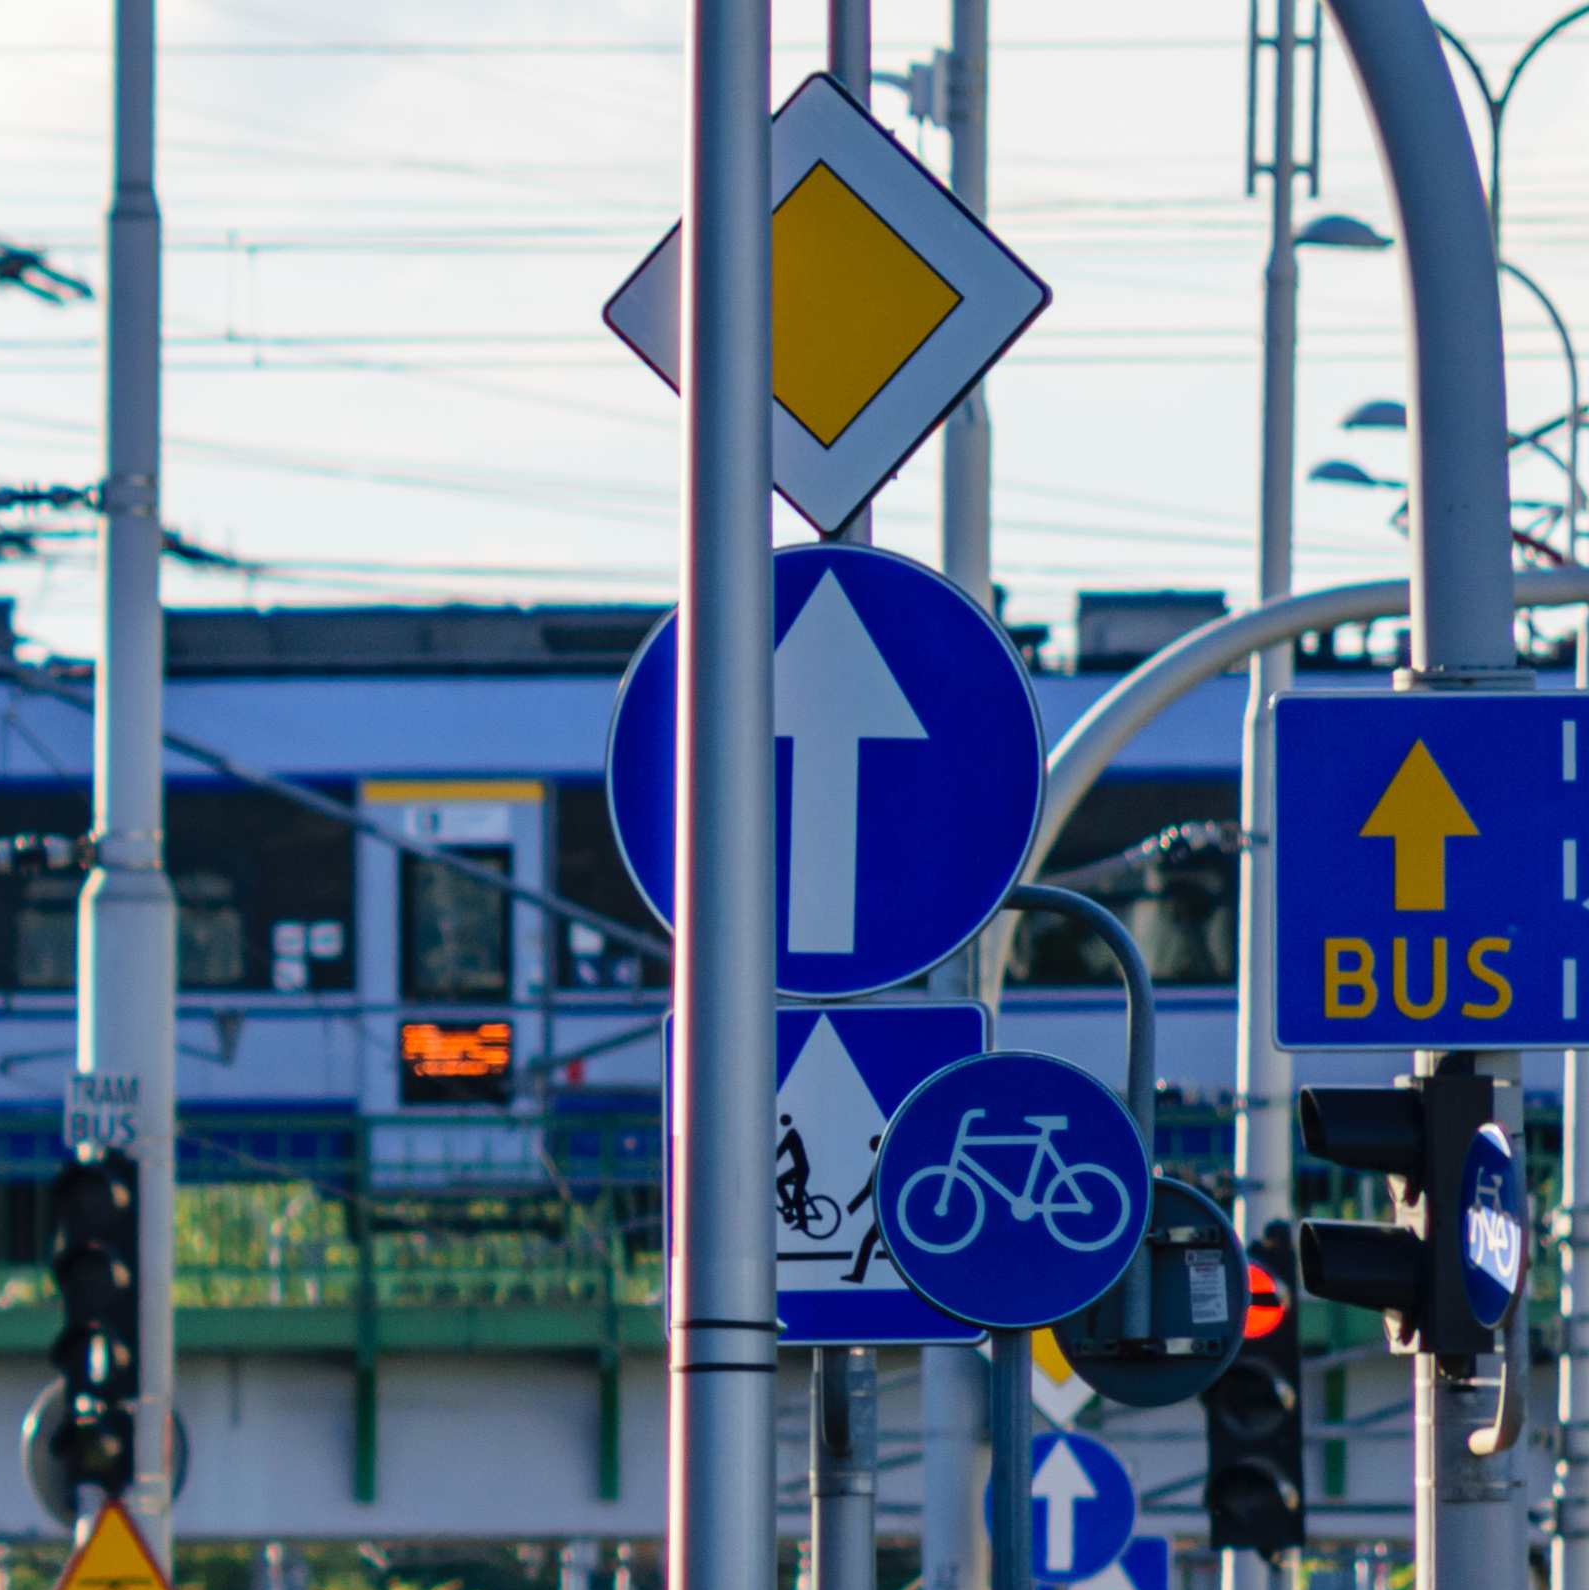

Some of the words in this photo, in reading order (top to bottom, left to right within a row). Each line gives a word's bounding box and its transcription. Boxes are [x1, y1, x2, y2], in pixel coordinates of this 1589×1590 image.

[1323, 936, 1513, 1020] BUS
[71, 1075, 139, 1107] TRAM
[70, 1112, 136, 1145] BUS
